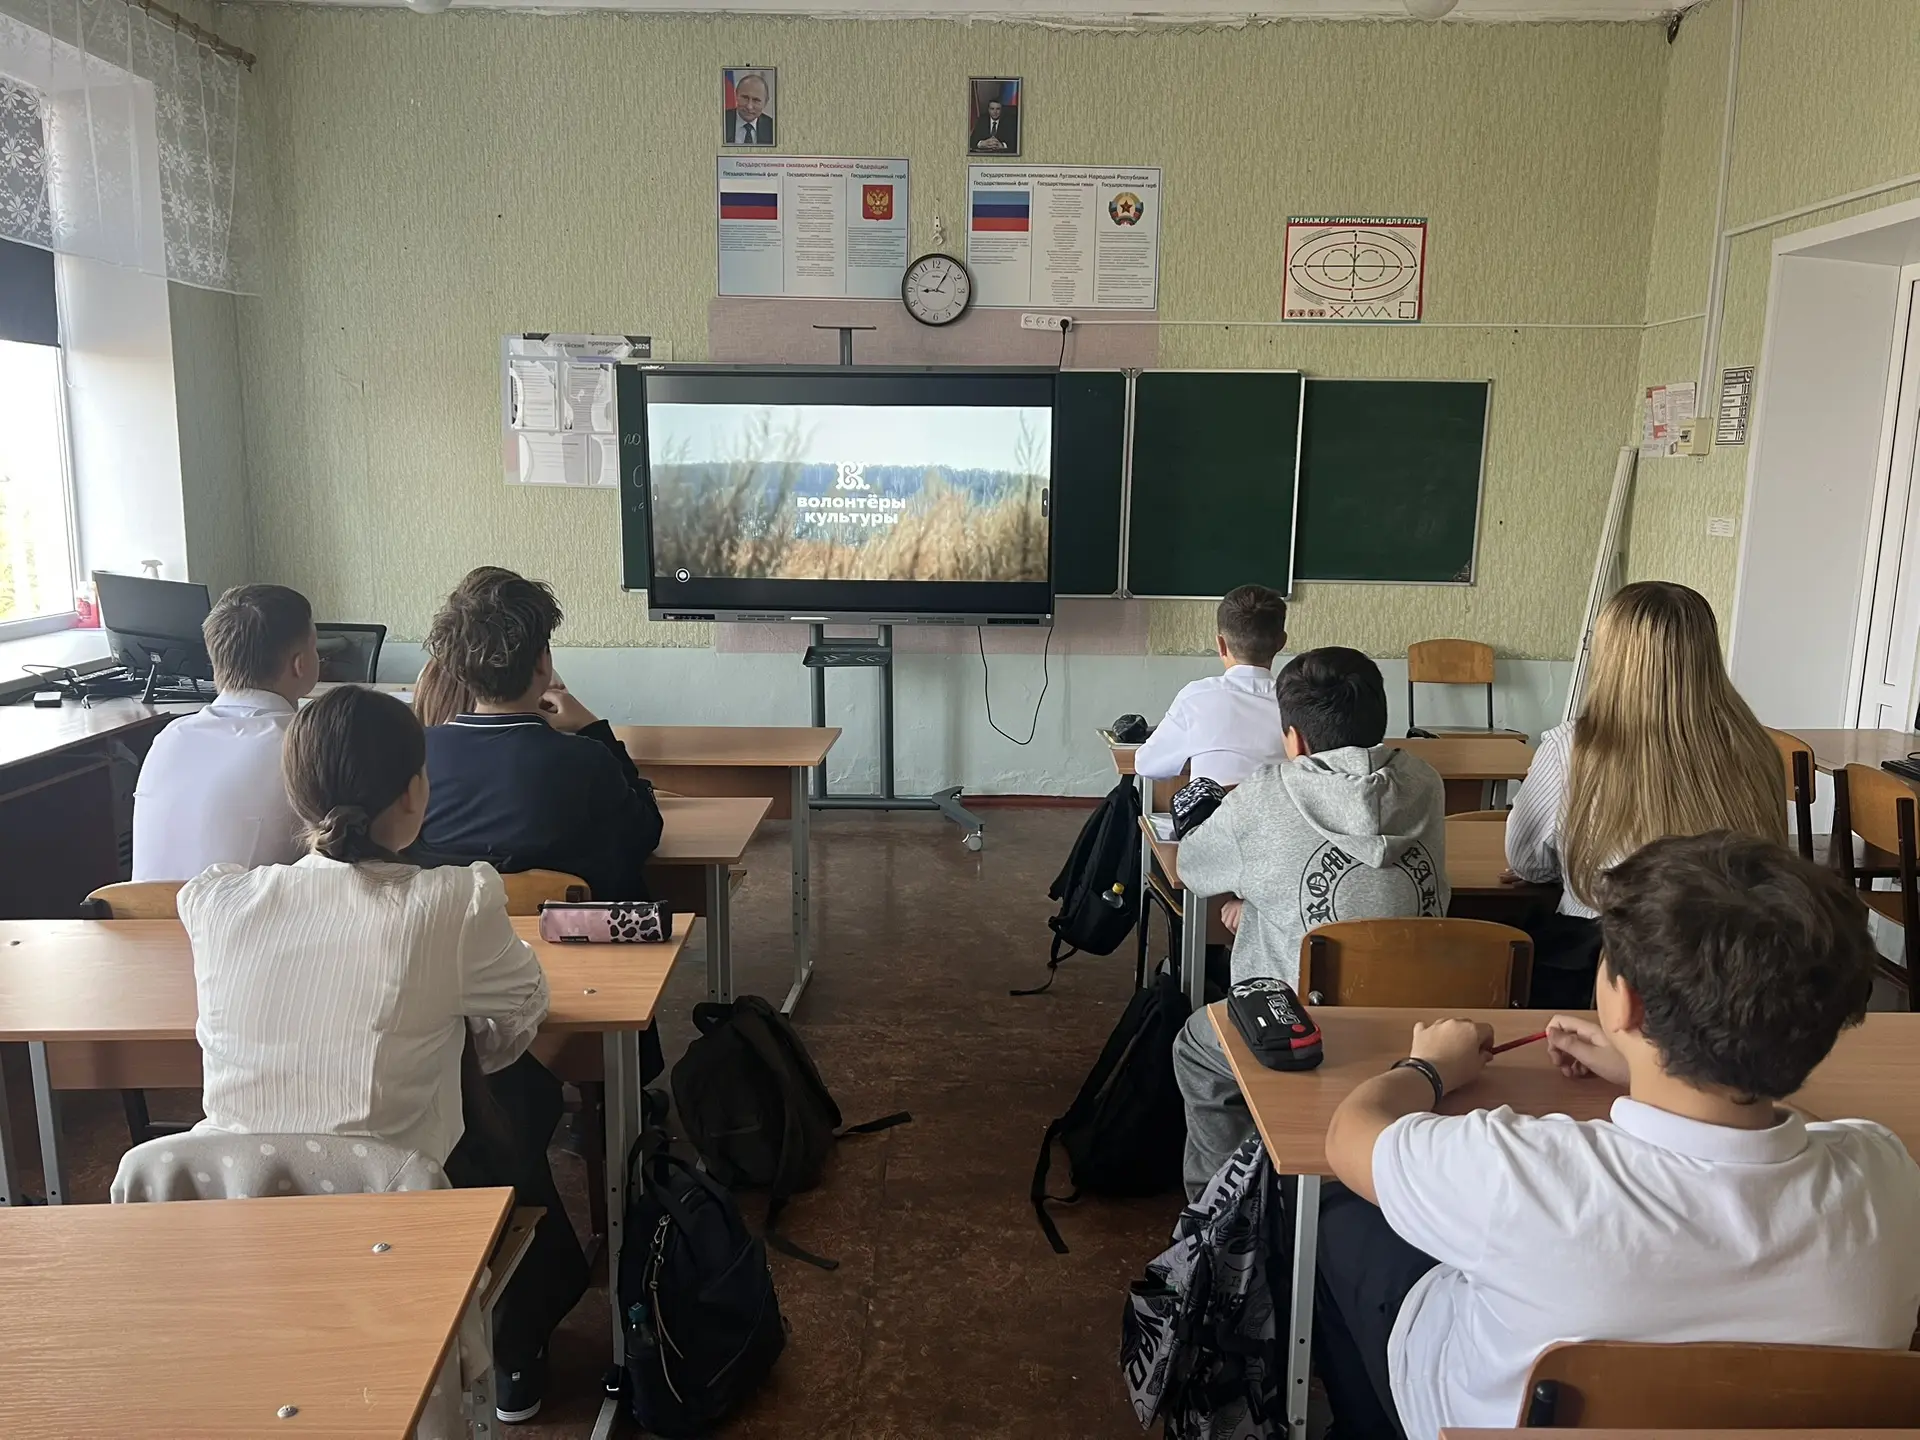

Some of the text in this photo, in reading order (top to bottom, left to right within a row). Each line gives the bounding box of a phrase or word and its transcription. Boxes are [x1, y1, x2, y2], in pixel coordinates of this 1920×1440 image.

[735, 161, 785, 169] Государственная
[920, 263, 928, 273] 11
[932, 260, 941, 269] 12
[910, 272, 920, 282] 10
[954, 274, 962, 282] 2
[907, 286, 916, 294] 9
[910, 299, 918, 308] 8
[920, 308, 928, 316] 7
[945, 309, 952, 318] 5
[932, 313, 939, 321] 6
[796, 493, 906, 512] волонтёры
[804, 512, 899, 527] культуры
